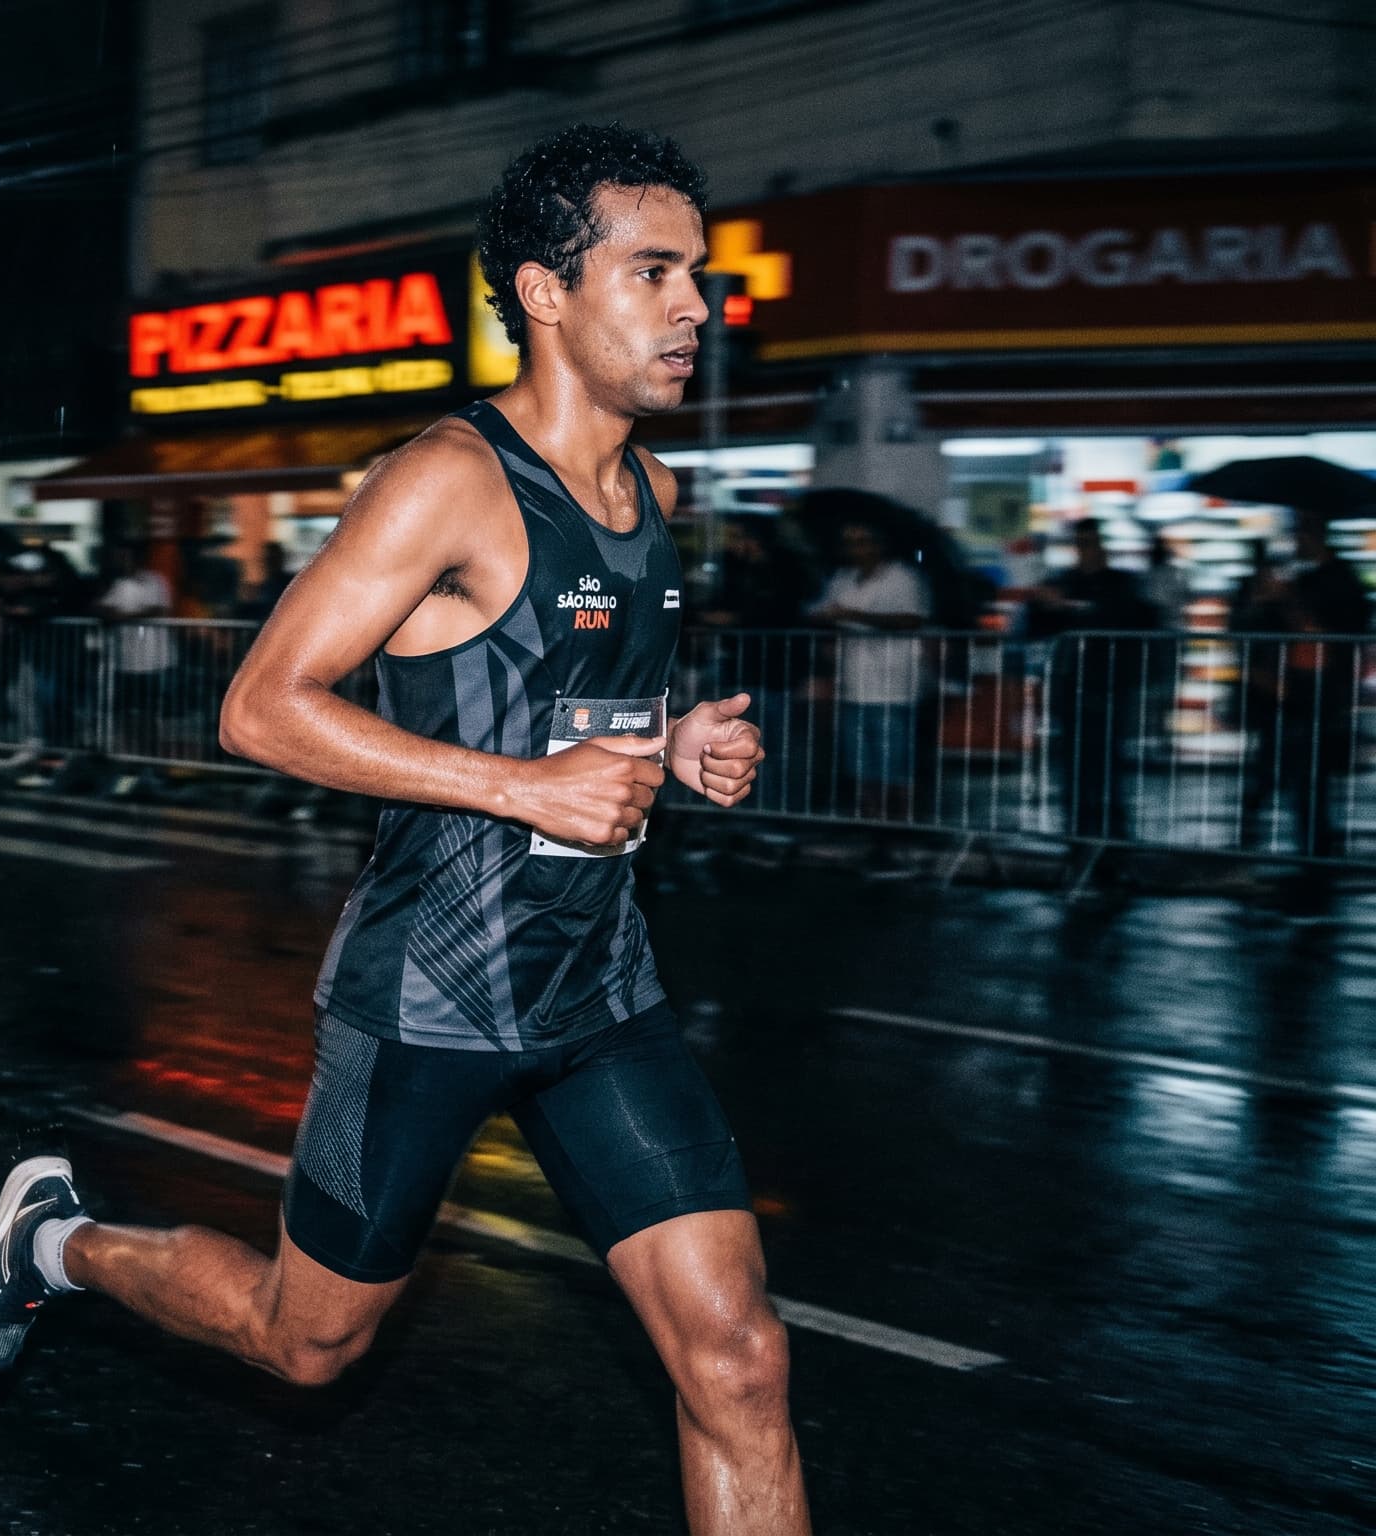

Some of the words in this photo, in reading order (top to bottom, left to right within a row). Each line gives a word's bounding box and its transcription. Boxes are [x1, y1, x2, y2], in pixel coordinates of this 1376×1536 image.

[889, 223, 1352, 292] DROGARIA
[129, 273, 452, 377] PIZZARIA
[579, 574, 601, 592] SÃO
[557, 591, 584, 609] SÃO
[574, 610, 610, 630] RUN
